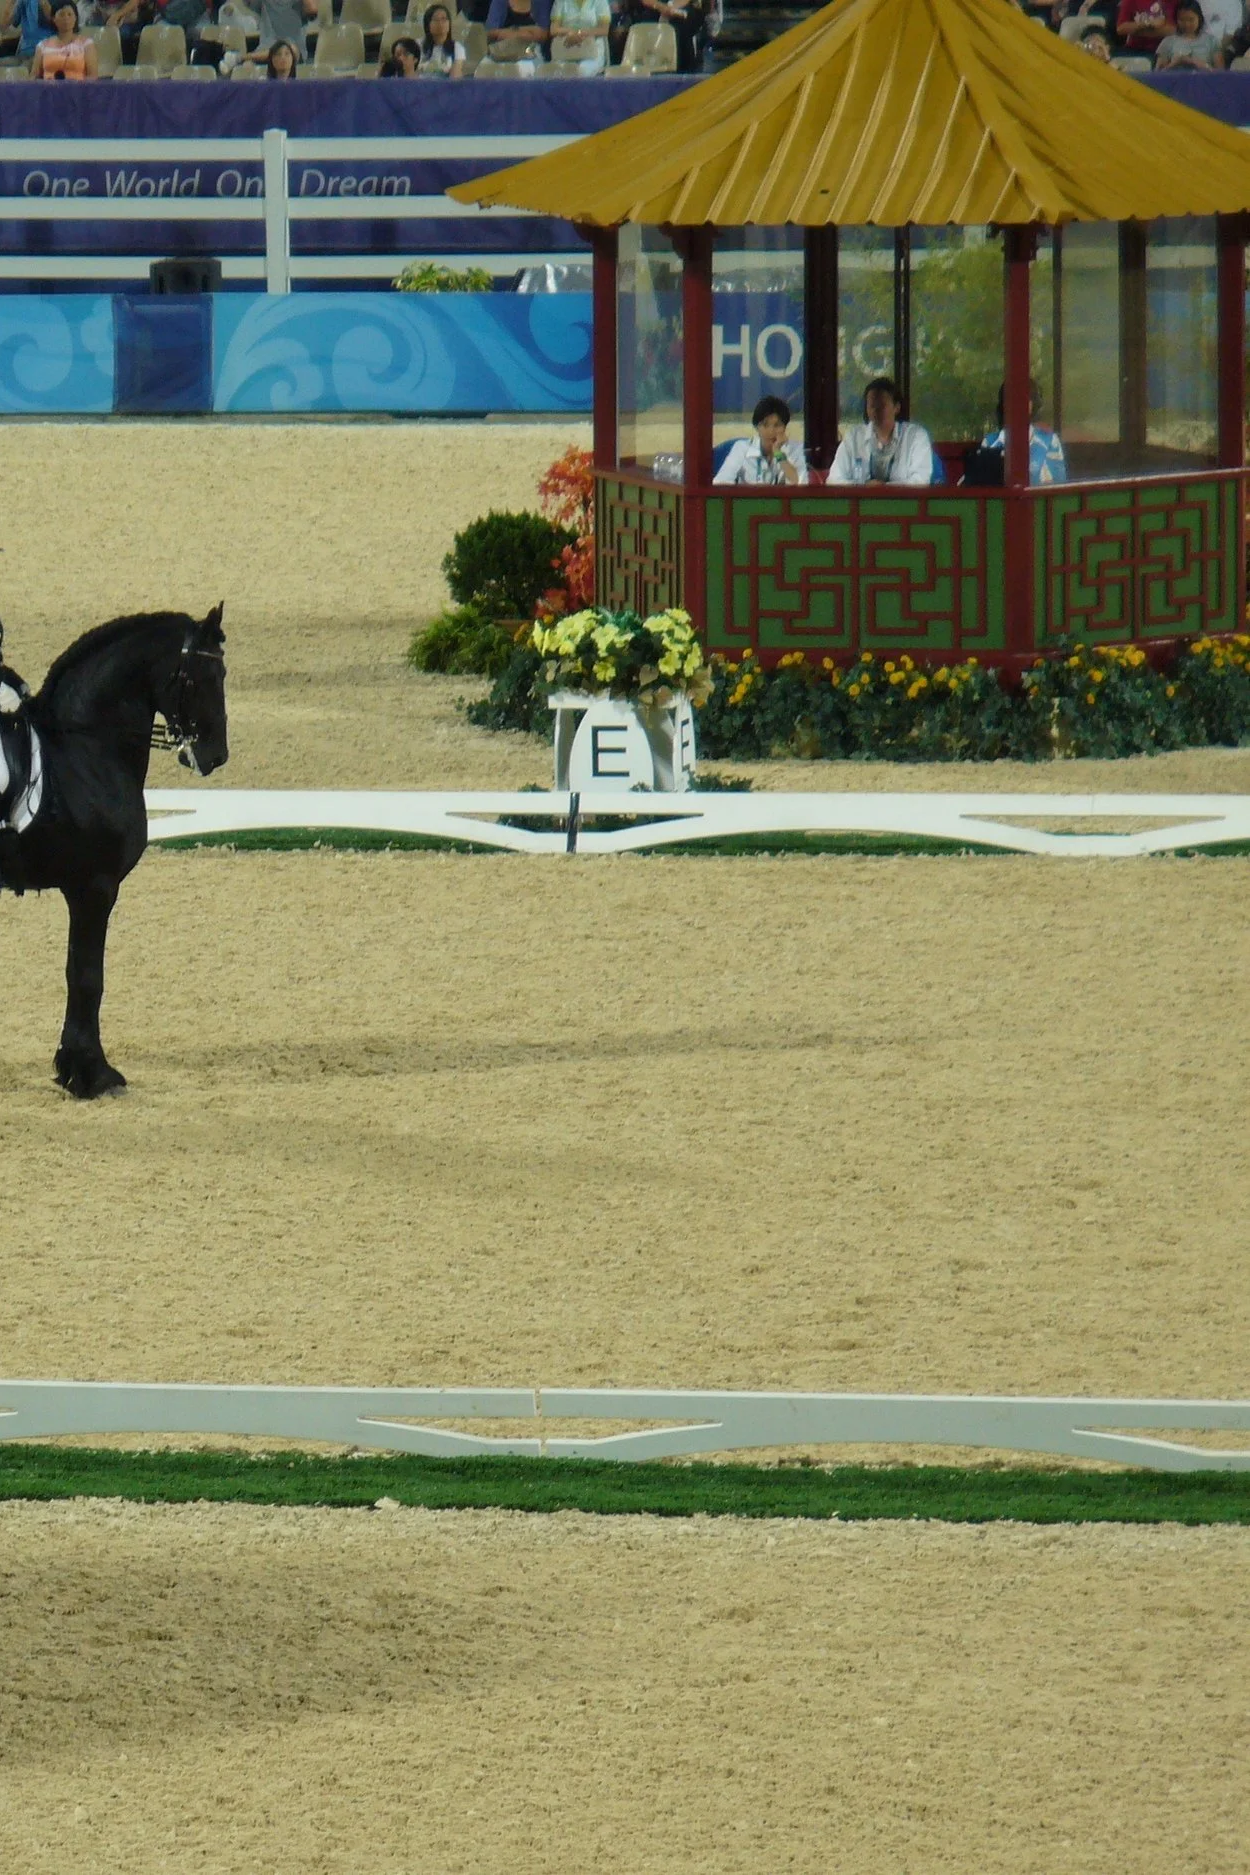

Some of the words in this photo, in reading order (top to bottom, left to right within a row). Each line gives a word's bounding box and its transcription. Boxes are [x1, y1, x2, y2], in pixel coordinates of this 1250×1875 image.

[23, 169, 90, 197] One
[105, 168, 200, 197] World
[216, 169, 265, 197] On
[300, 168, 411, 197] Dream
[712, 324, 895, 378] HOG
[591, 725, 630, 777] E
